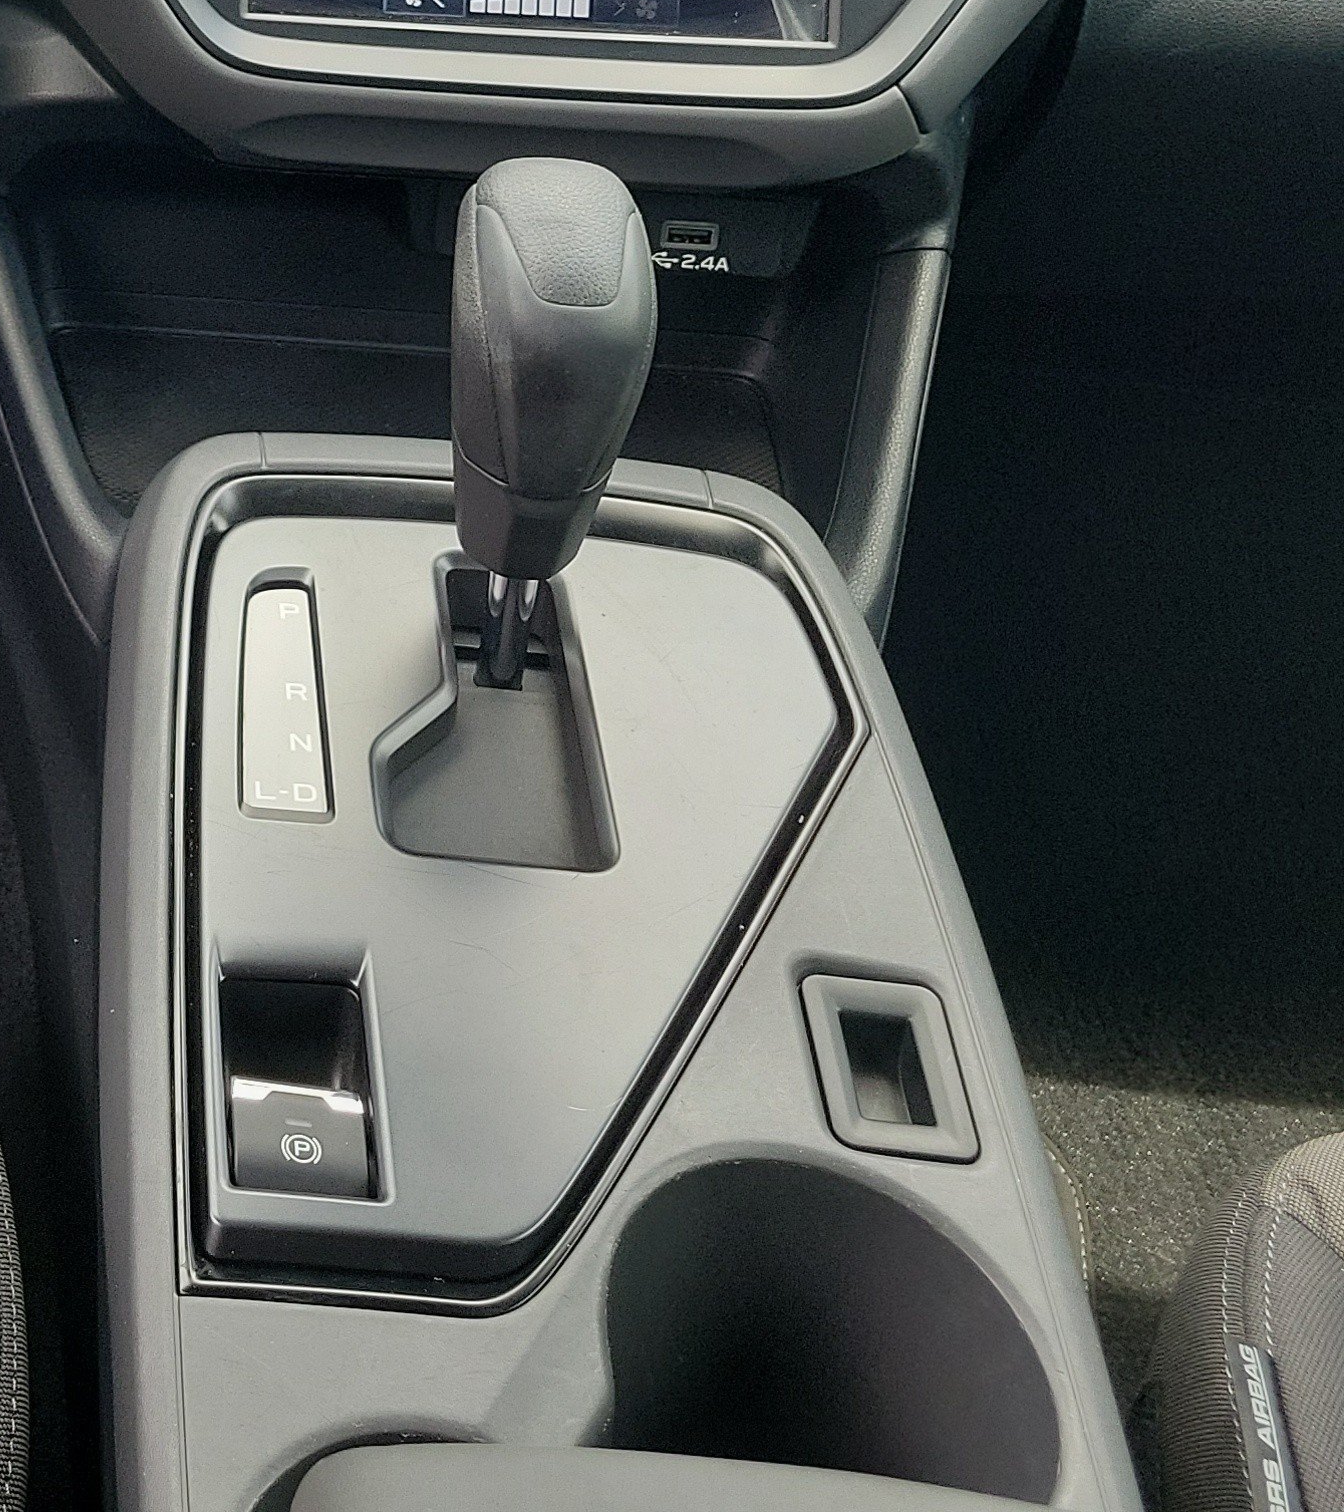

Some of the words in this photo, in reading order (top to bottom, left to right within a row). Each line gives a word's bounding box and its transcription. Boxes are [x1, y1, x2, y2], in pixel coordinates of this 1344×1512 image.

[681, 254, 730, 272] 2.4A
[278, 602, 300, 619] P
[285, 682, 308, 701] R
[289, 733, 312, 752] N
[1239, 1343, 1276, 1450] AIRBAG
